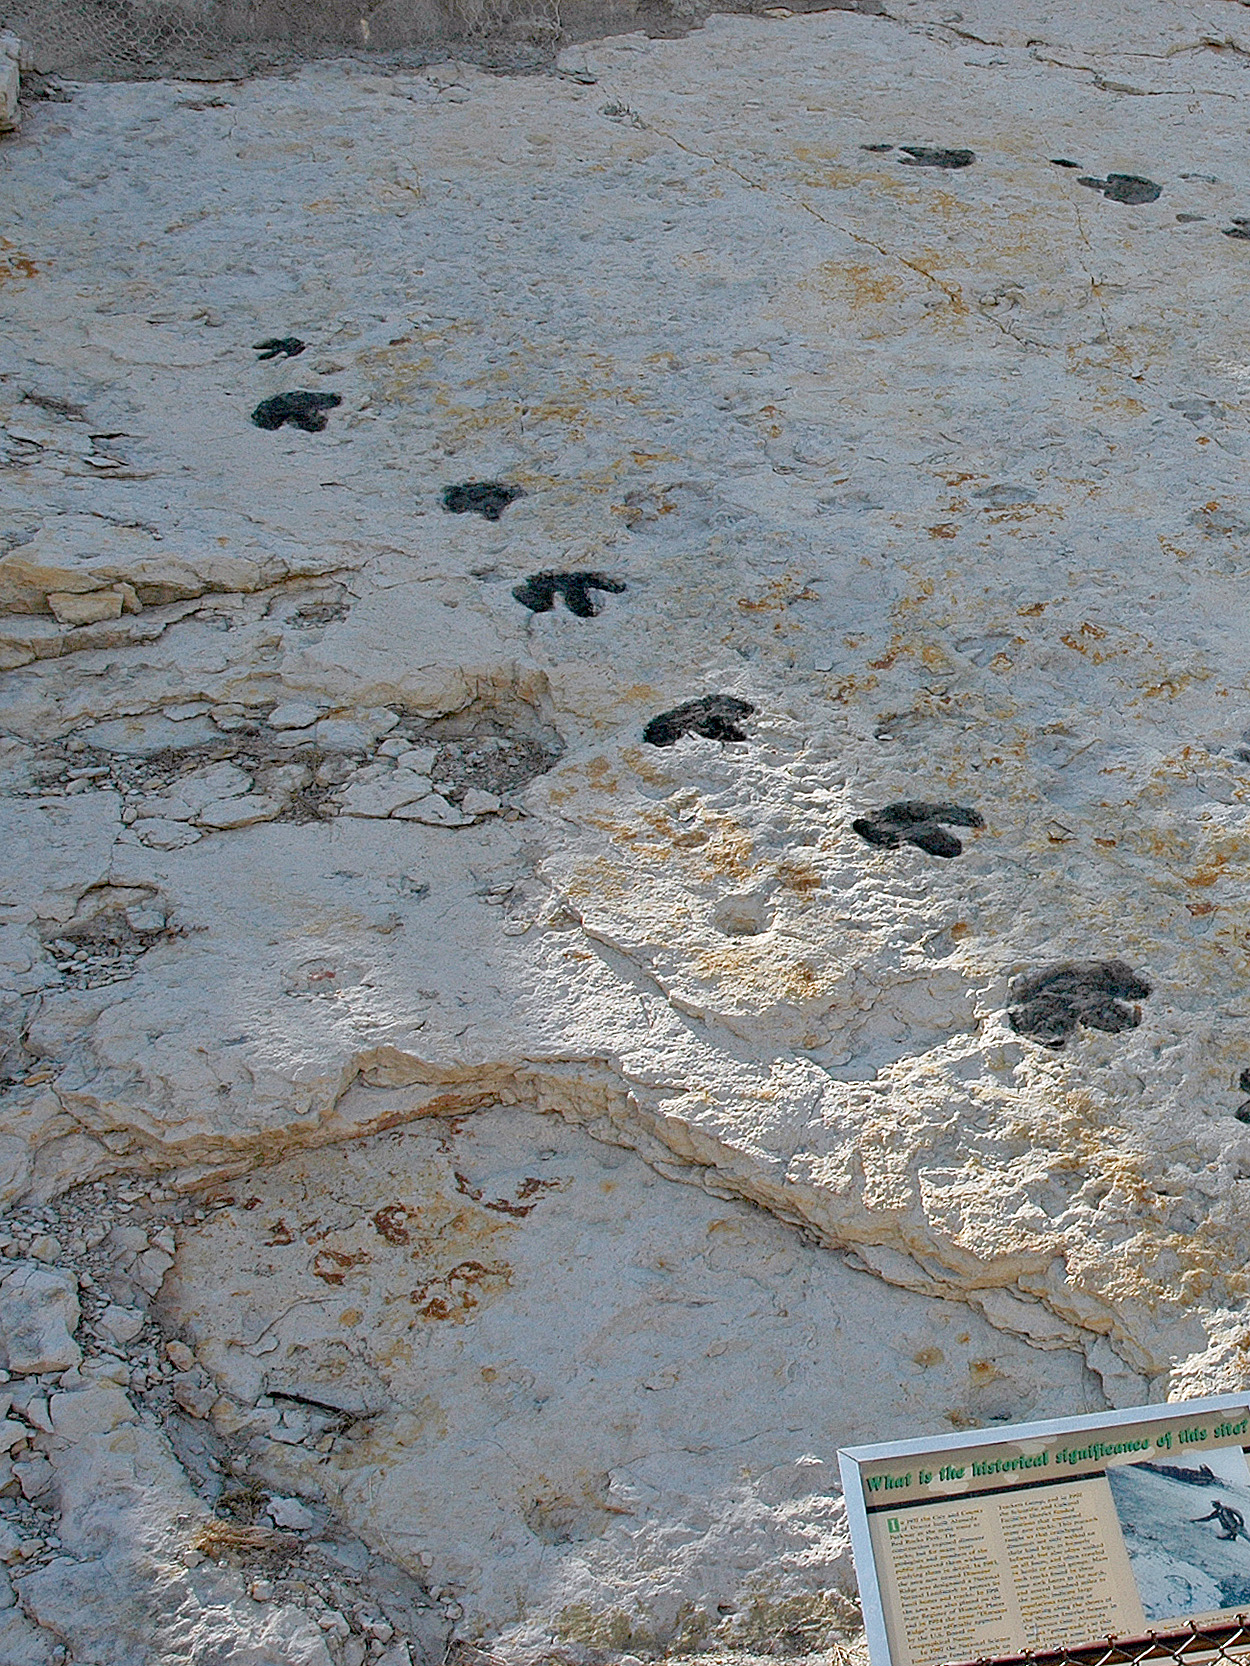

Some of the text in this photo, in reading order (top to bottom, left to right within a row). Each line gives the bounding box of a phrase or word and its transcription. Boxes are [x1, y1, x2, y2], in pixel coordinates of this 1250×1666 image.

[868, 1418, 1249, 1492] What is the historical significance of this site?
